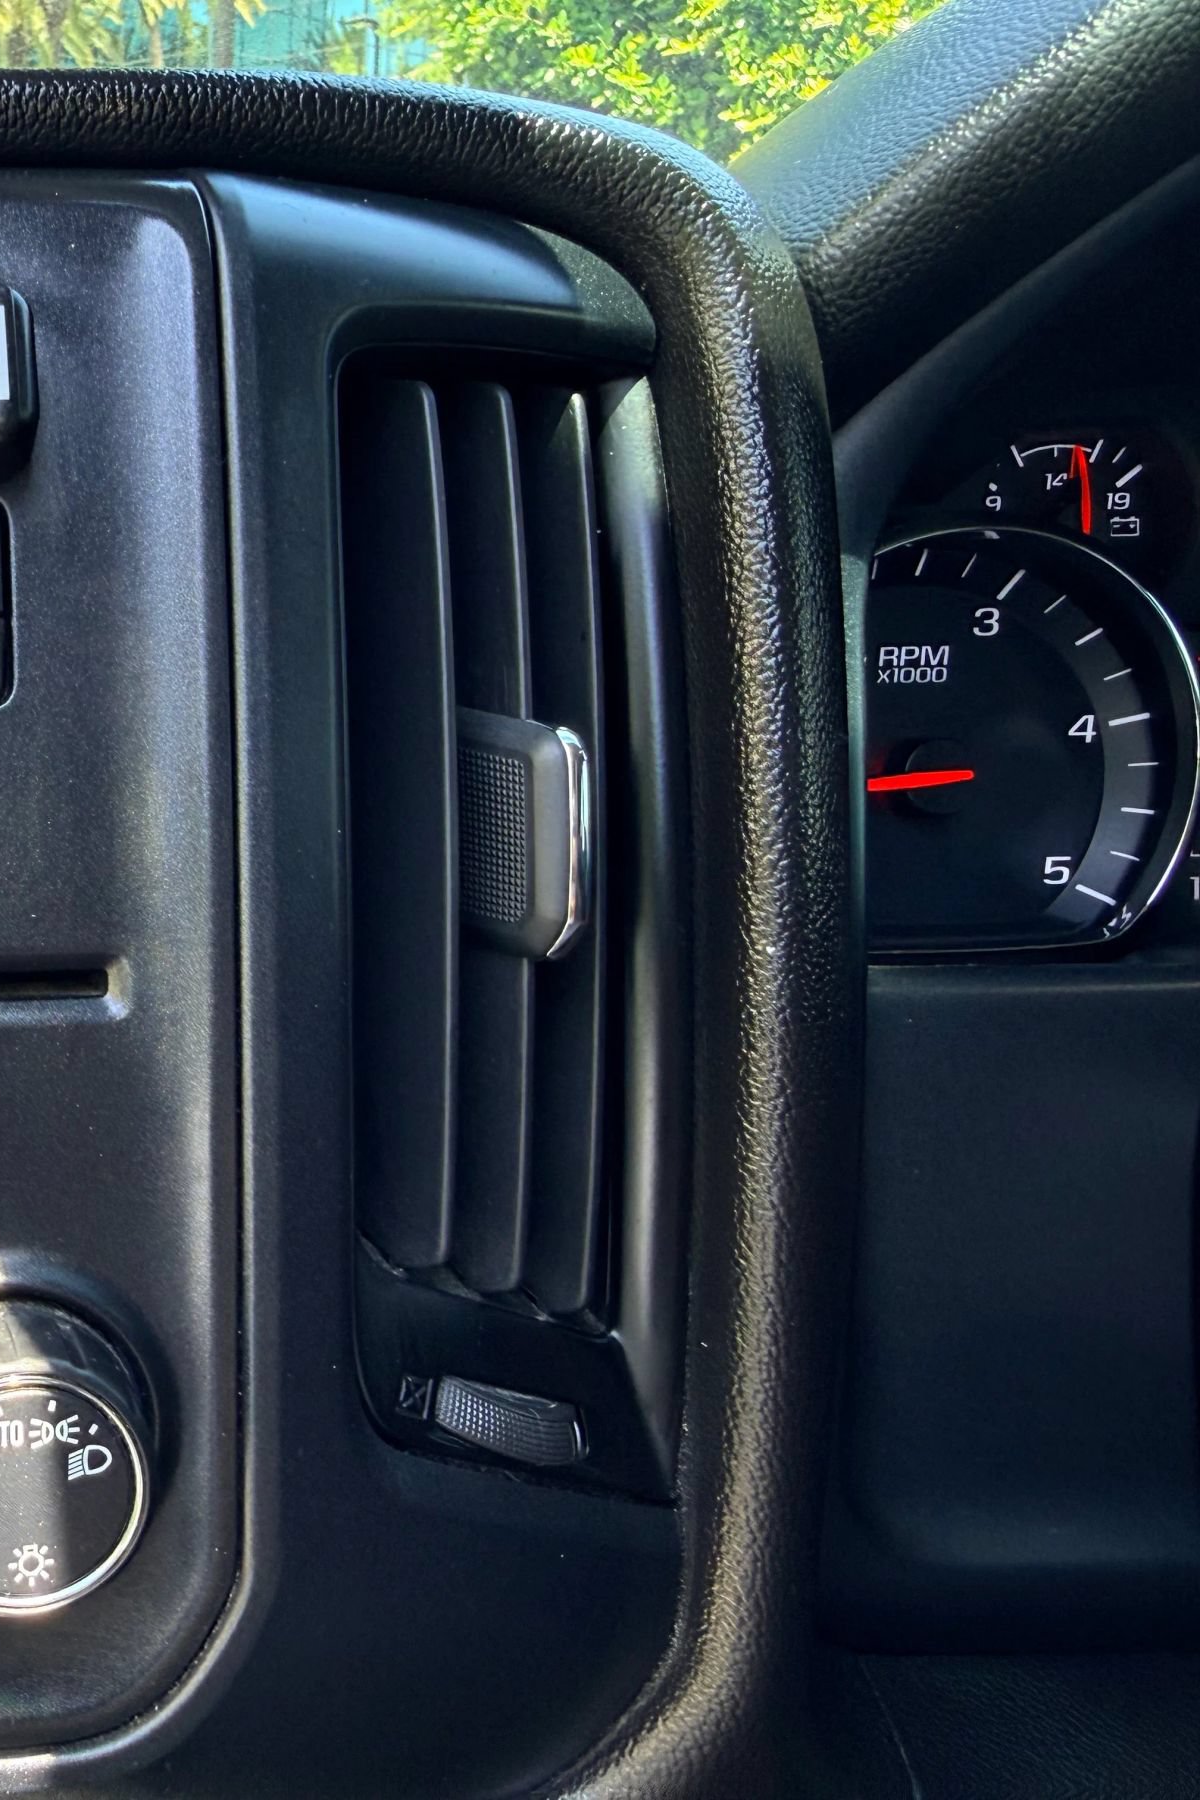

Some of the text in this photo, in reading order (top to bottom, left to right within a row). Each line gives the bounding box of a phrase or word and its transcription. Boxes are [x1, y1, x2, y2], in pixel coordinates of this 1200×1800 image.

[985, 495, 1002, 512] 9
[1106, 492, 1131, 510] 19
[972, 607, 1000, 637] 3
[878, 645, 950, 667] RPM
[1067, 714, 1097, 744] 4
[1043, 855, 1072, 885] 5
